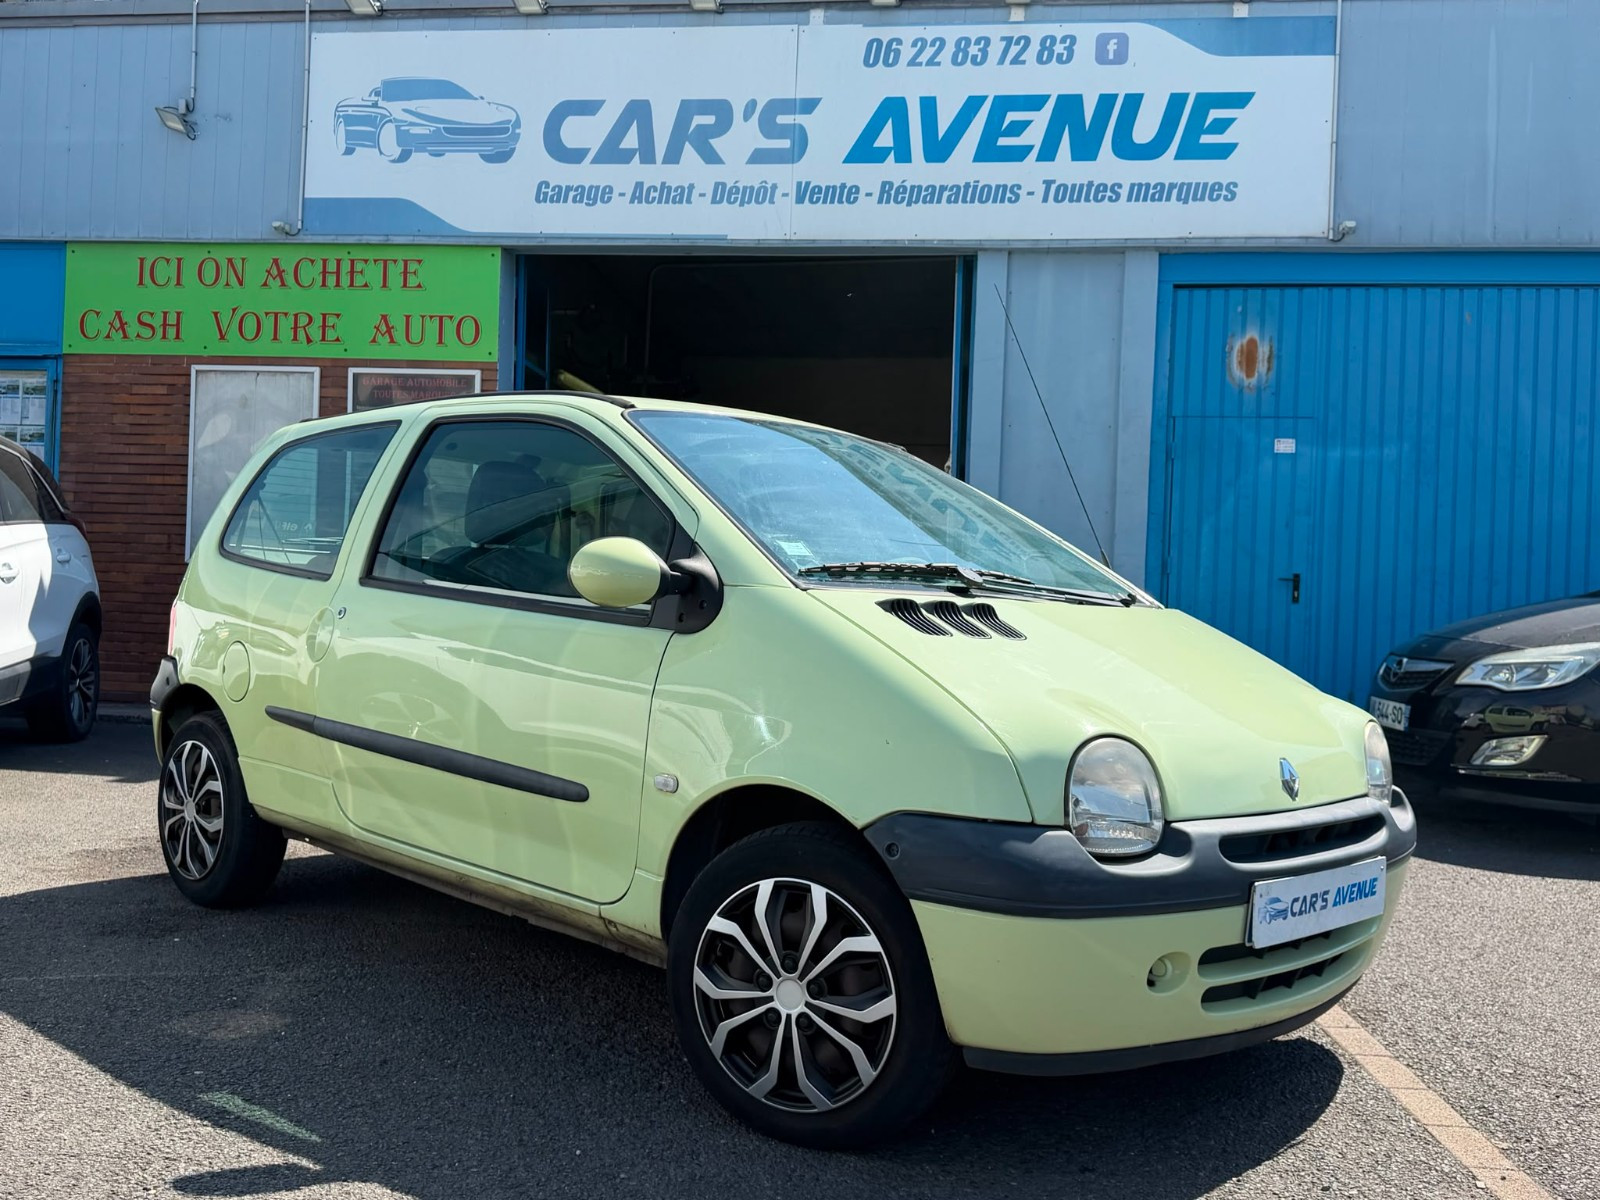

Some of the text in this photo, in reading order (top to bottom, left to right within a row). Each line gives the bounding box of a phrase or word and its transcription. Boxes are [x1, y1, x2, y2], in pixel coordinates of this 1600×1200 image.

[862, 34, 1077, 68] 06 22 83 72 83
[543, 91, 1256, 165] CAR'S AVENUE
[534, 180, 614, 207] Garage
[628, 181, 695, 205] Achat
[710, 180, 778, 207] Dépôt
[794, 180, 861, 205] Vente
[876, 179, 1022, 207] Réparations
[1041, 179, 1123, 204] Toutes
[1126, 181, 1239, 205] marques
[136, 256, 426, 291] ICI ON ACHETE
[79, 305, 482, 347] CASH VOTRE AUTO
[362, 376, 467, 387] GARAGE AUTOMOBILE
[373, 389, 409, 399] TOUTES
[1289, 877, 1378, 918] CAR'S AVENUE
